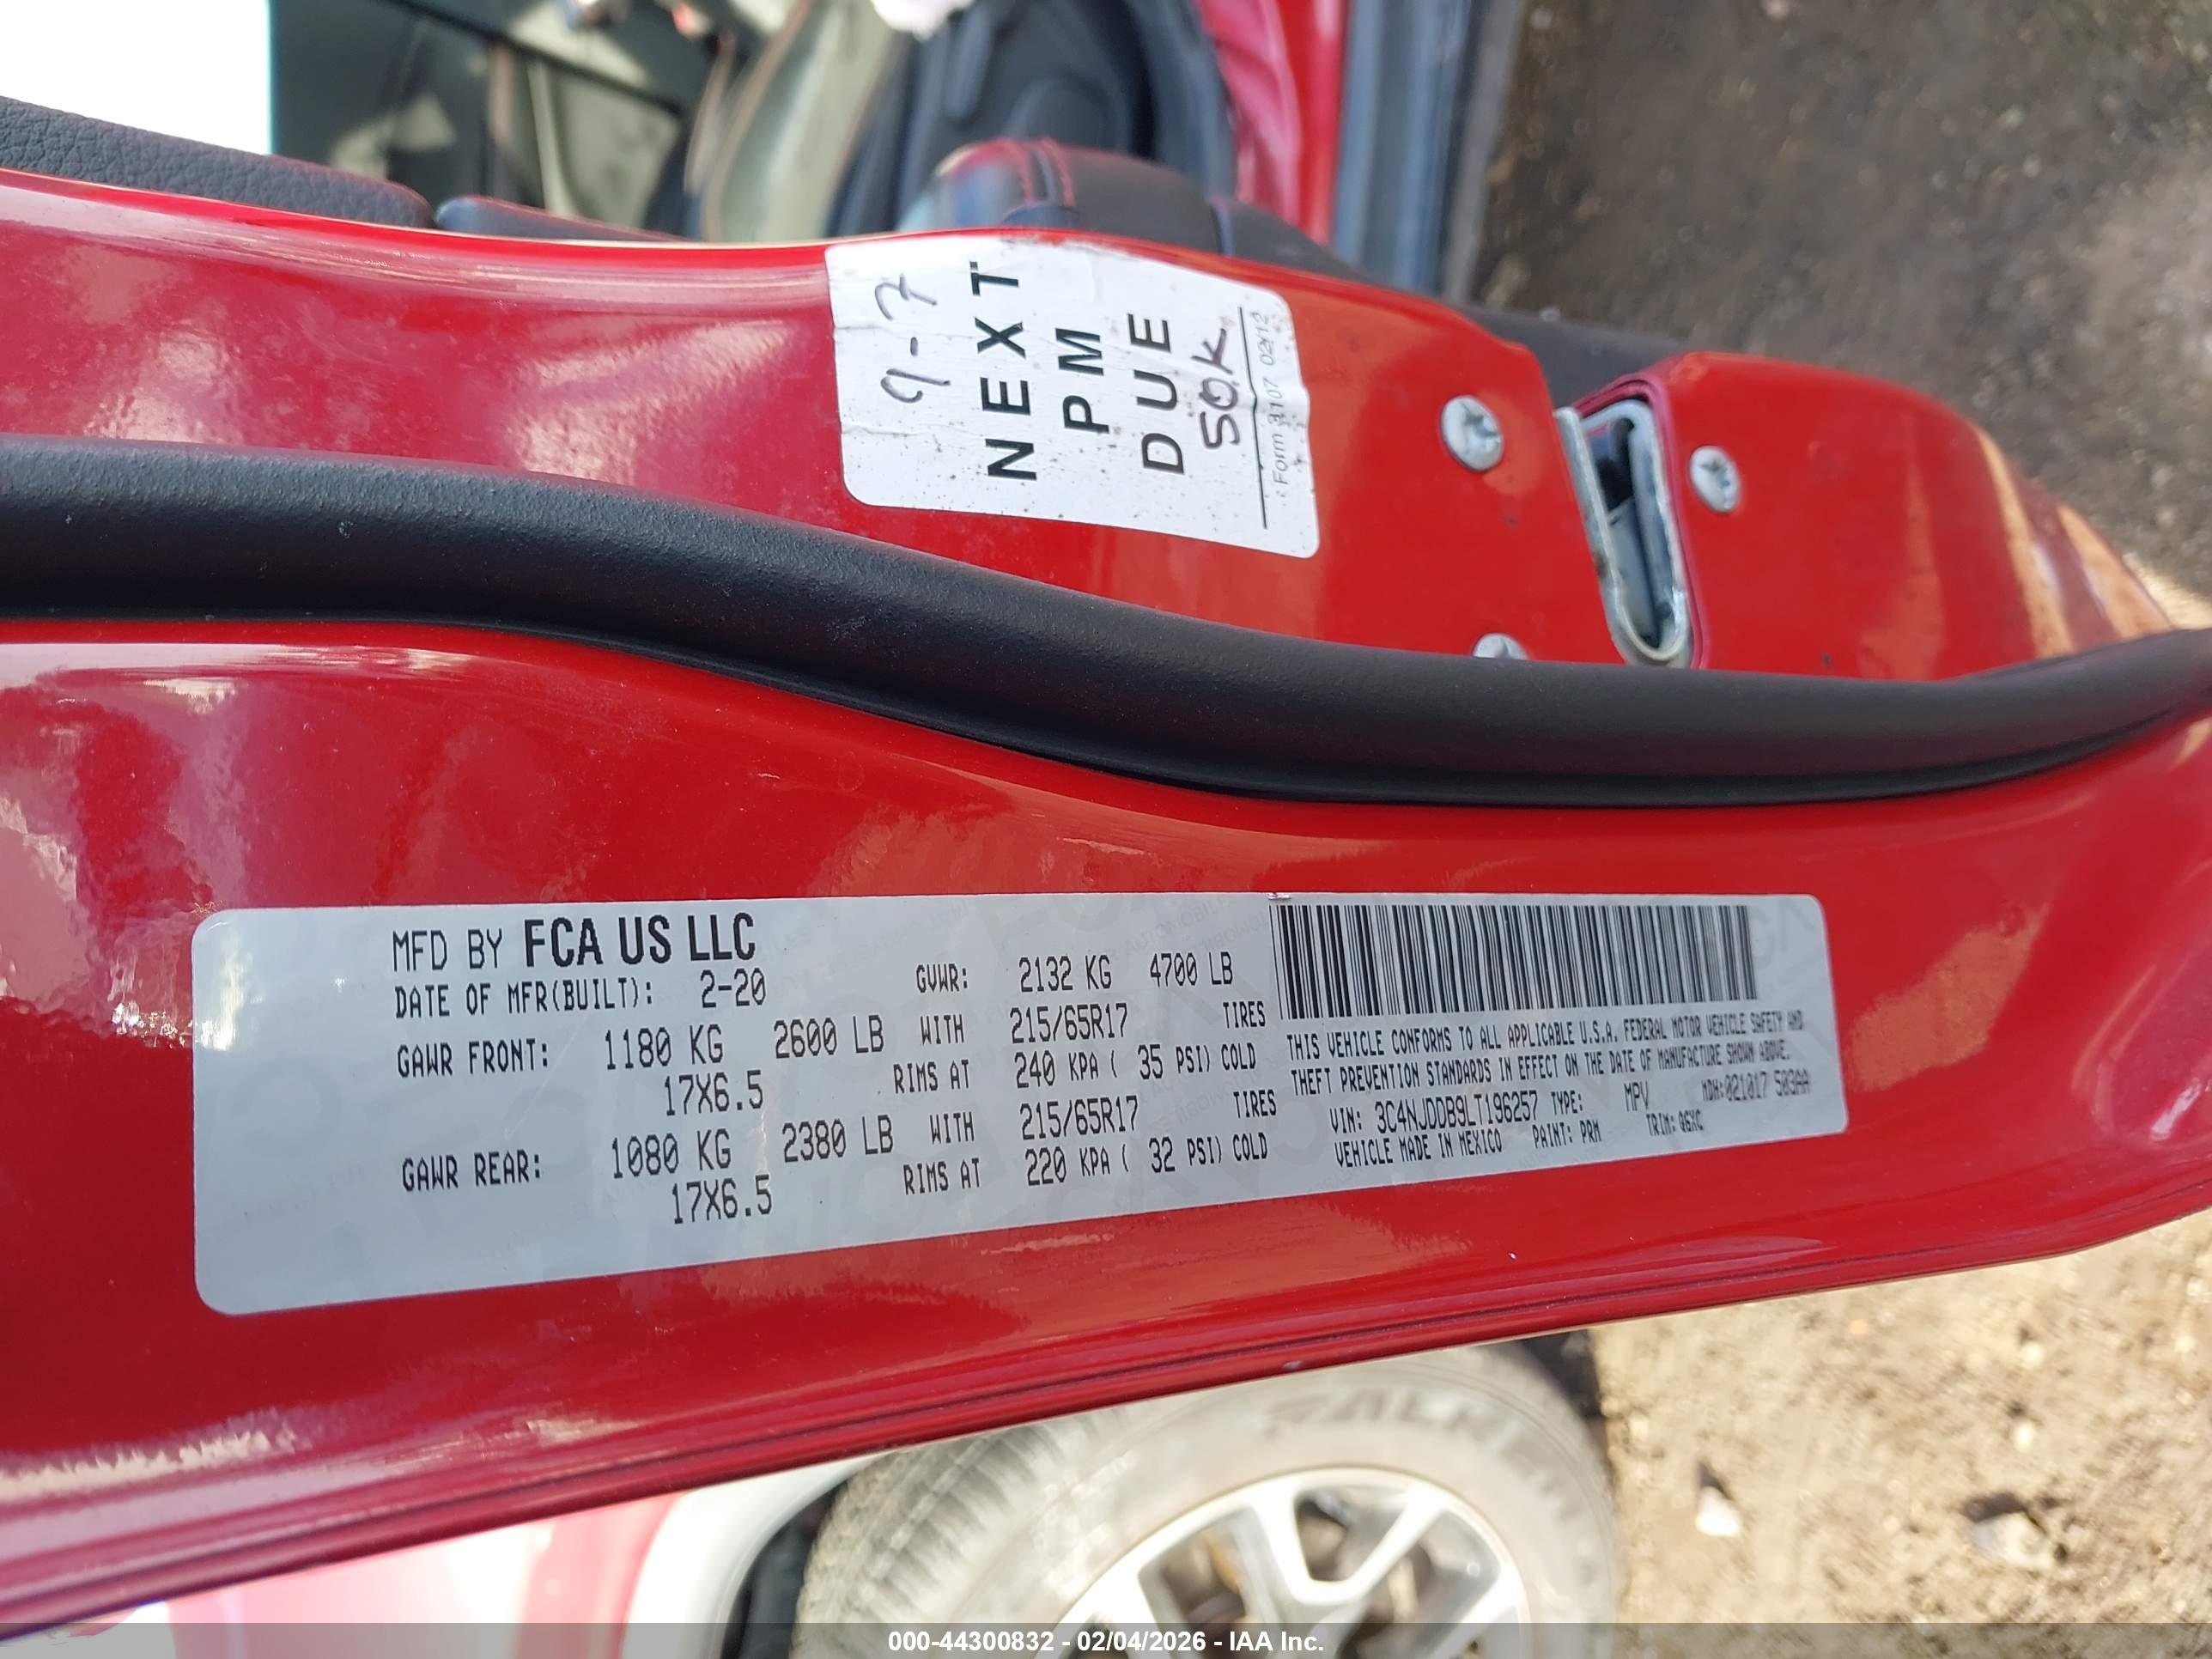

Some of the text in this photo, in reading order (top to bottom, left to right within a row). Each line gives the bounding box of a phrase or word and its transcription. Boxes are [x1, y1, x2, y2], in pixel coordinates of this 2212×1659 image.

[969, 260, 1037, 482] NEXT
[1055, 327, 1109, 434] PM
[1127, 313, 1185, 475] DUE
[1268, 431, 1290, 486] Form
[392, 912, 756, 973] MFD BY FCA US LLC
[916, 951, 1233, 993] GVWR: 2132 KG 4700 LB
[395, 968, 766, 1019] DATE OF MFR(BUILT): 2-20
[397, 1000, 1266, 1078] GAWR FRONT: 1180 KG 2600 LB WITH 215/65R17 TIRES
[1286, 1032, 1321, 1060] THIS
[1327, 1030, 1384, 1059] VEHICLE
[1391, 1027, 1453, 1054] CONFORMS
[1459, 1025, 1474, 1051] TO
[1480, 1024, 1502, 1050] ALL
[1508, 1020, 1575, 1048] APPLICABLE
[1579, 1019, 1619, 1045] U.S.A.
[1623, 1017, 1668, 1042] FEDERAL
[1671, 1015, 1702, 1038] MOTOR
[1705, 1012, 1747, 1037] VEHICLE
[1750, 1011, 1783, 1034] SAFETY
[665, 1069, 763, 1115] 17X6.5
[893, 1061, 939, 1094] RIMS
[950, 1059, 969, 1090] AT
[1014, 1050, 1055, 1089] 240
[1068, 1051, 1099, 1082] KPA
[1138, 1043, 1164, 1079] 35
[1176, 1044, 1211, 1074] PSI)
[1221, 1042, 1256, 1072] COLD
[1291, 1067, 1332, 1097] THEFT
[1339, 1061, 1420, 1093] PREVENTION
[1426, 1057, 1492, 1086] STANDARDS
[1498, 1055, 1512, 1082] IN
[1517, 1054, 1558, 1079] EFFECT
[1565, 1052, 1578, 1075] ON
[1584, 1050, 1604, 1075] THE
[1609, 1048, 1636, 1073] DATE
[1640, 1048, 1652, 1072] OF
[1657, 1043, 1722, 1071] MANUFACTURE
[1726, 1040, 1754, 1064] SHOWN
[1330, 1106, 1363, 1133] VIN:
[1374, 1090, 1538, 1133] 3C4NJDDB9LT196257
[1551, 1090, 1583, 1116] TYPE:
[1624, 1081, 1649, 1111] MPV
[402, 1157, 459, 1192] GAWR
[474, 1152, 542, 1187] REAR:
[611, 1136, 679, 1180] 1080
[697, 1129, 732, 1172] KG
[782, 1119, 847, 1164] 2380
[861, 1115, 894, 1155] LB
[929, 1111, 975, 1145] WITH
[1020, 1095, 1139, 1140] 215/65R17
[1233, 1089, 1278, 1119] TIRES
[1334, 1138, 1393, 1168] VEHICLE
[1399, 1134, 1431, 1160] MADE
[1437, 1132, 1453, 1158] IN
[1458, 1127, 1503, 1156] MEXICO
[1533, 1121, 1572, 1148] PAINT:
[1579, 1119, 1601, 1144] PRM
[672, 1174, 773, 1224] 17X6.5
[903, 1161, 949, 1195] RIMS
[960, 1158, 981, 1189] AT
[1024, 1146, 1067, 1186] 220
[1079, 1146, 1110, 1177] KPA
[1148, 1136, 1176, 1173] 32
[1188, 1135, 1223, 1166] PSI)
[1232, 1132, 1268, 1162] COLD
